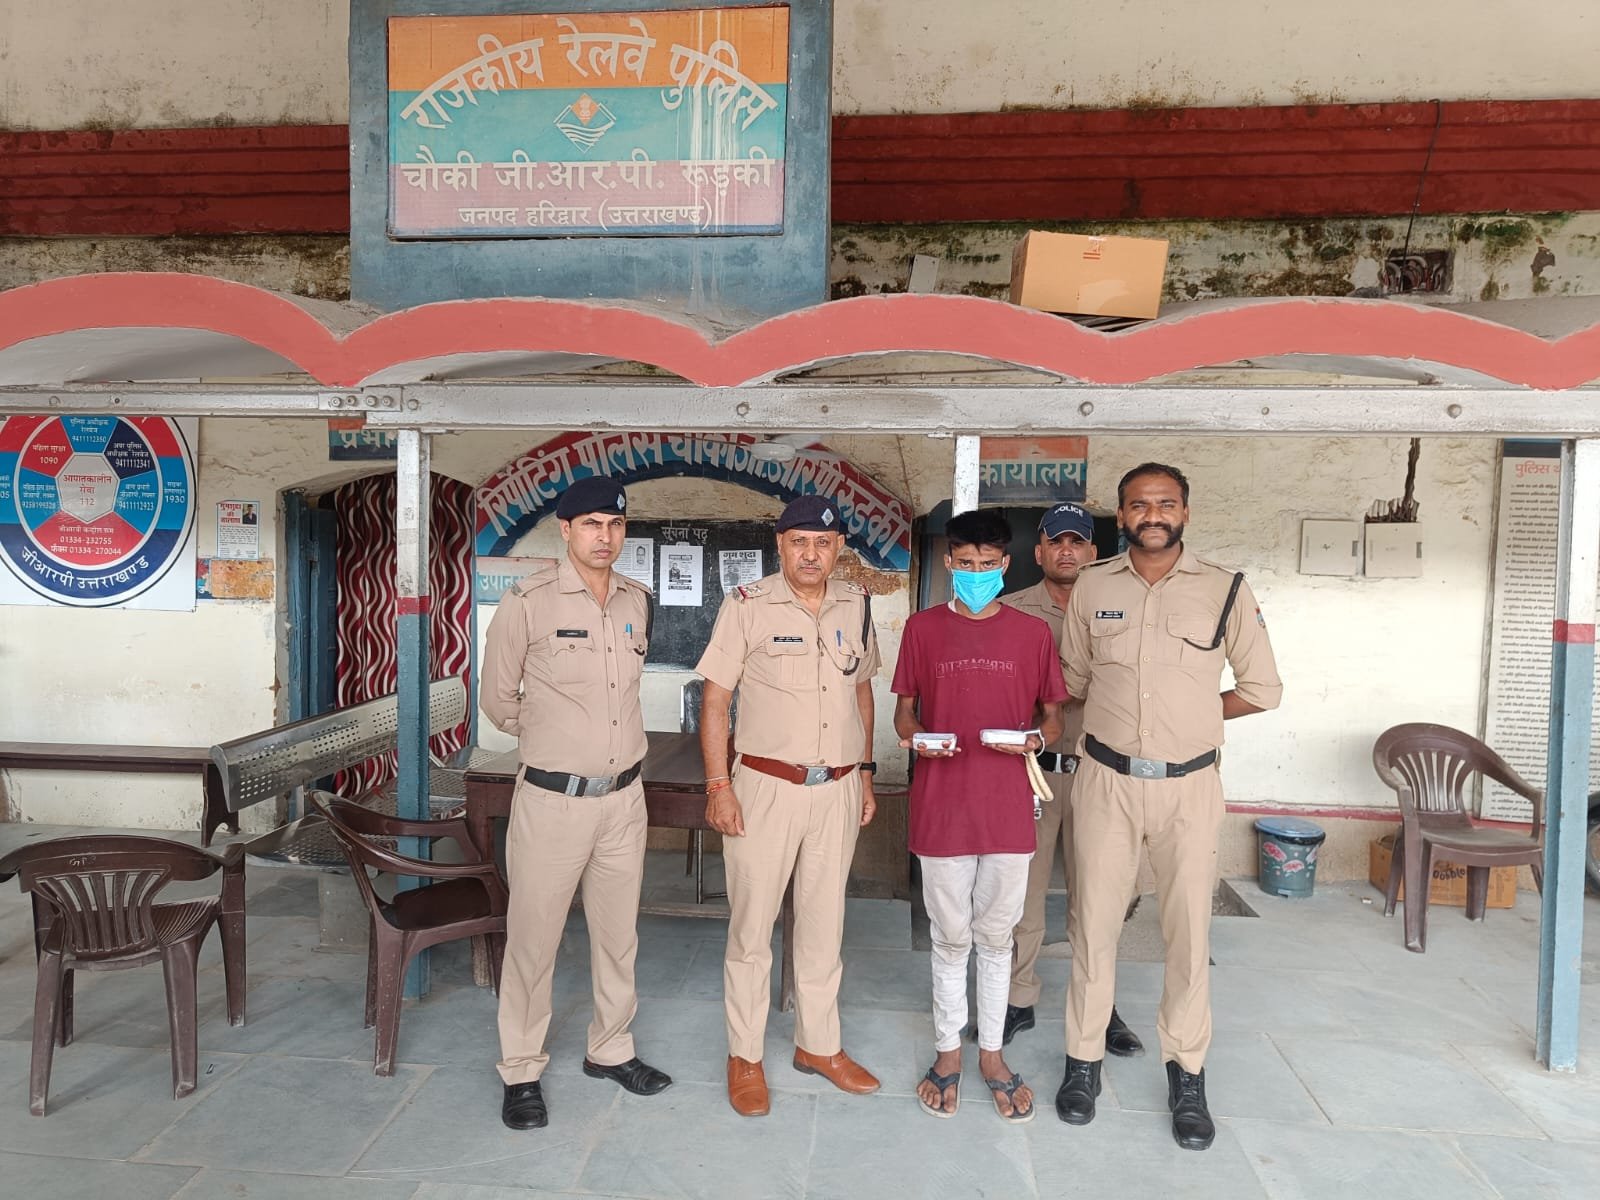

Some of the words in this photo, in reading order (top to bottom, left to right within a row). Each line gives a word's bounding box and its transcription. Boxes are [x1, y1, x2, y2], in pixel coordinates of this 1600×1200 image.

[400, 34, 545, 128] राजकीय
[556, 17, 656, 82] रेलवे
[661, 40, 778, 131] पुलिस
[400, 144, 482, 192] चौकी
[458, 206, 519, 226] जनपद
[525, 200, 592, 227] हरिद्वार
[598, 199, 712, 231] (उत्तराखण्ड)
[40, 456, 59, 464] 1090
[1515, 460, 1549, 478] पुलिस
[63, 473, 112, 484] आपातकालीन
[80, 498, 95, 506] 112
[164, 495, 186, 504] 1930
[21, 545, 74, 588] जीआरपी
[76, 555, 150, 590] उत्तराखण्ड
